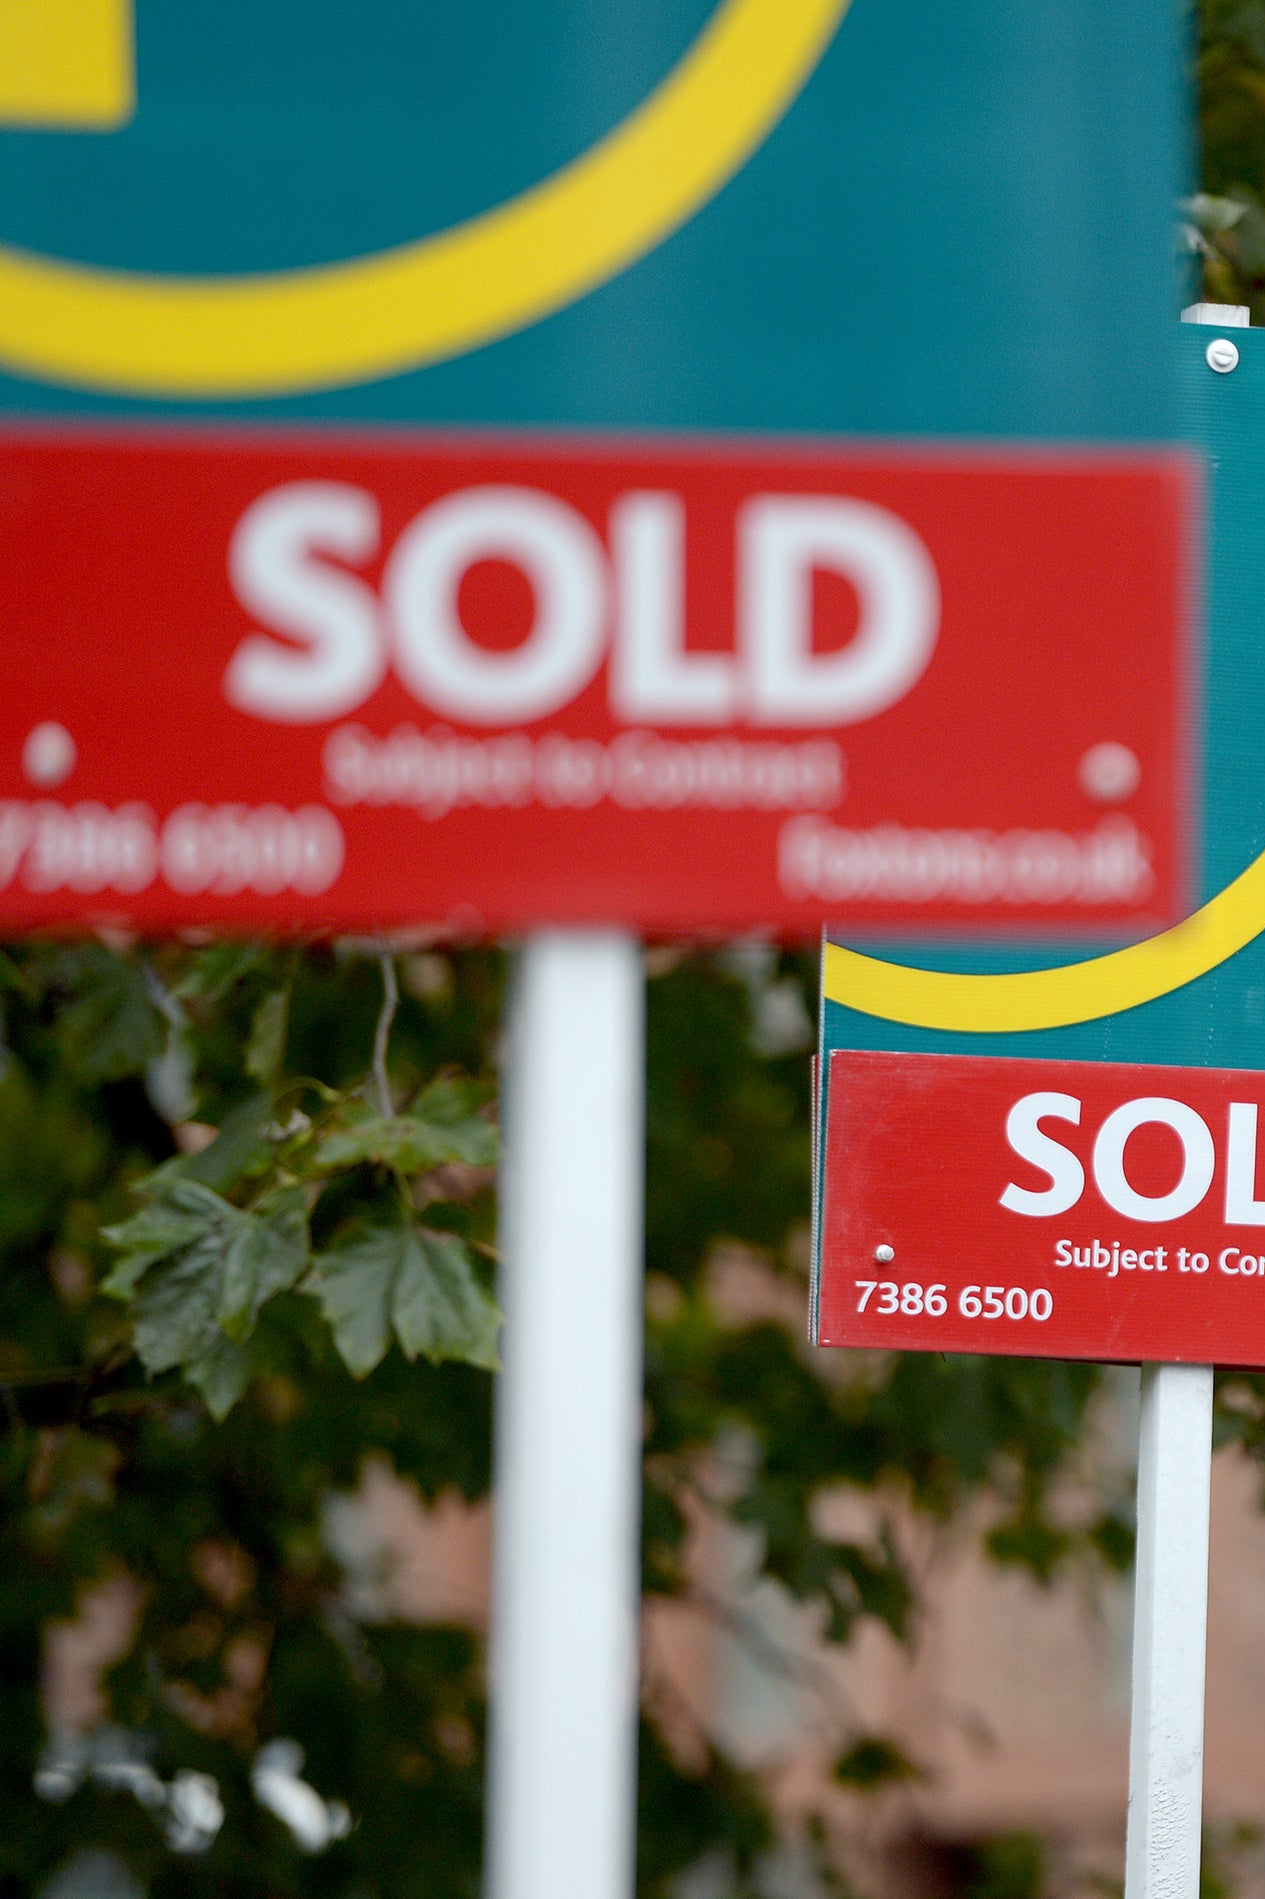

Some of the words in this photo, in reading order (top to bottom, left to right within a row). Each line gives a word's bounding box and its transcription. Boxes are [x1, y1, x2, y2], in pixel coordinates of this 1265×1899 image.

[226, 480, 940, 724] SOLD
[1056, 1240, 1167, 1277] Subject
[1178, 1249, 1209, 1273] to
[855, 1281, 947, 1317] 7386
[959, 1286, 1053, 1321] 6500
